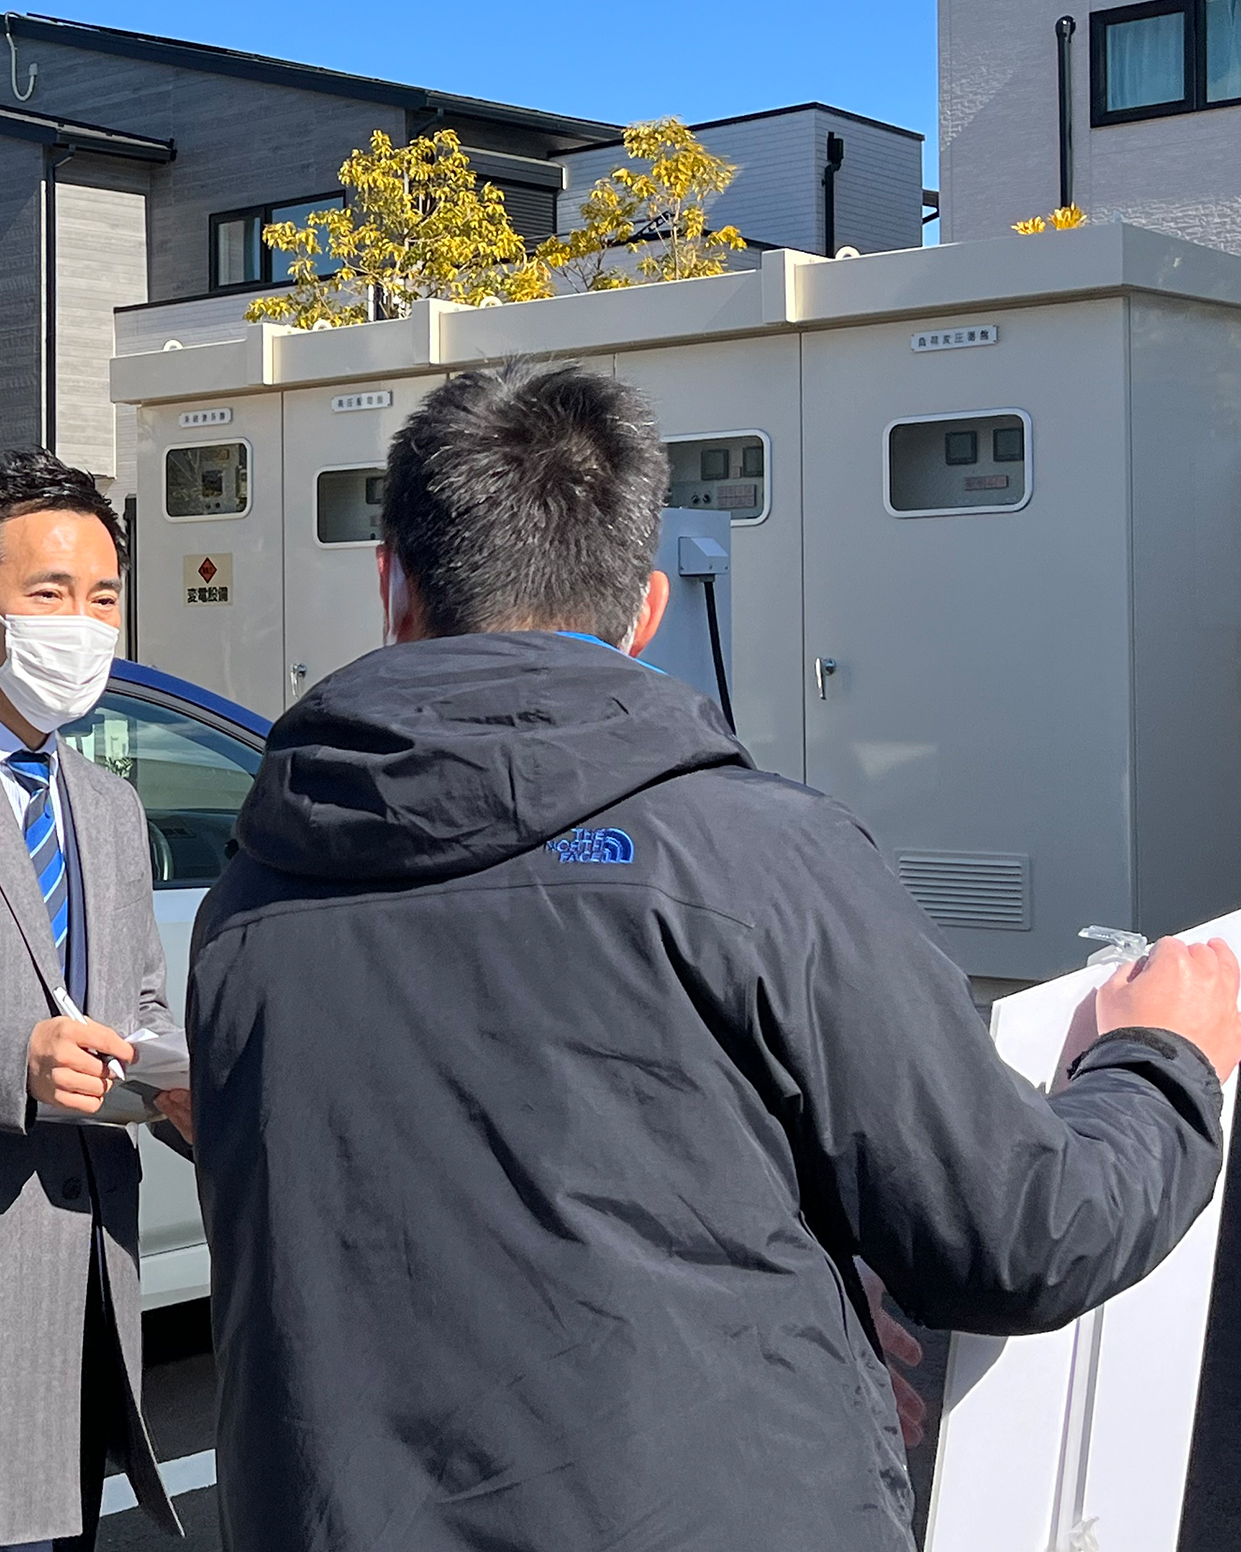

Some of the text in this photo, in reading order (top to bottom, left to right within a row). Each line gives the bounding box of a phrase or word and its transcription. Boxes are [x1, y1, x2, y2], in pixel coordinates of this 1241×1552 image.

[186, 585, 229, 604] 変電設備
[571, 828, 605, 840] THE
[559, 851, 601, 863] FACE
